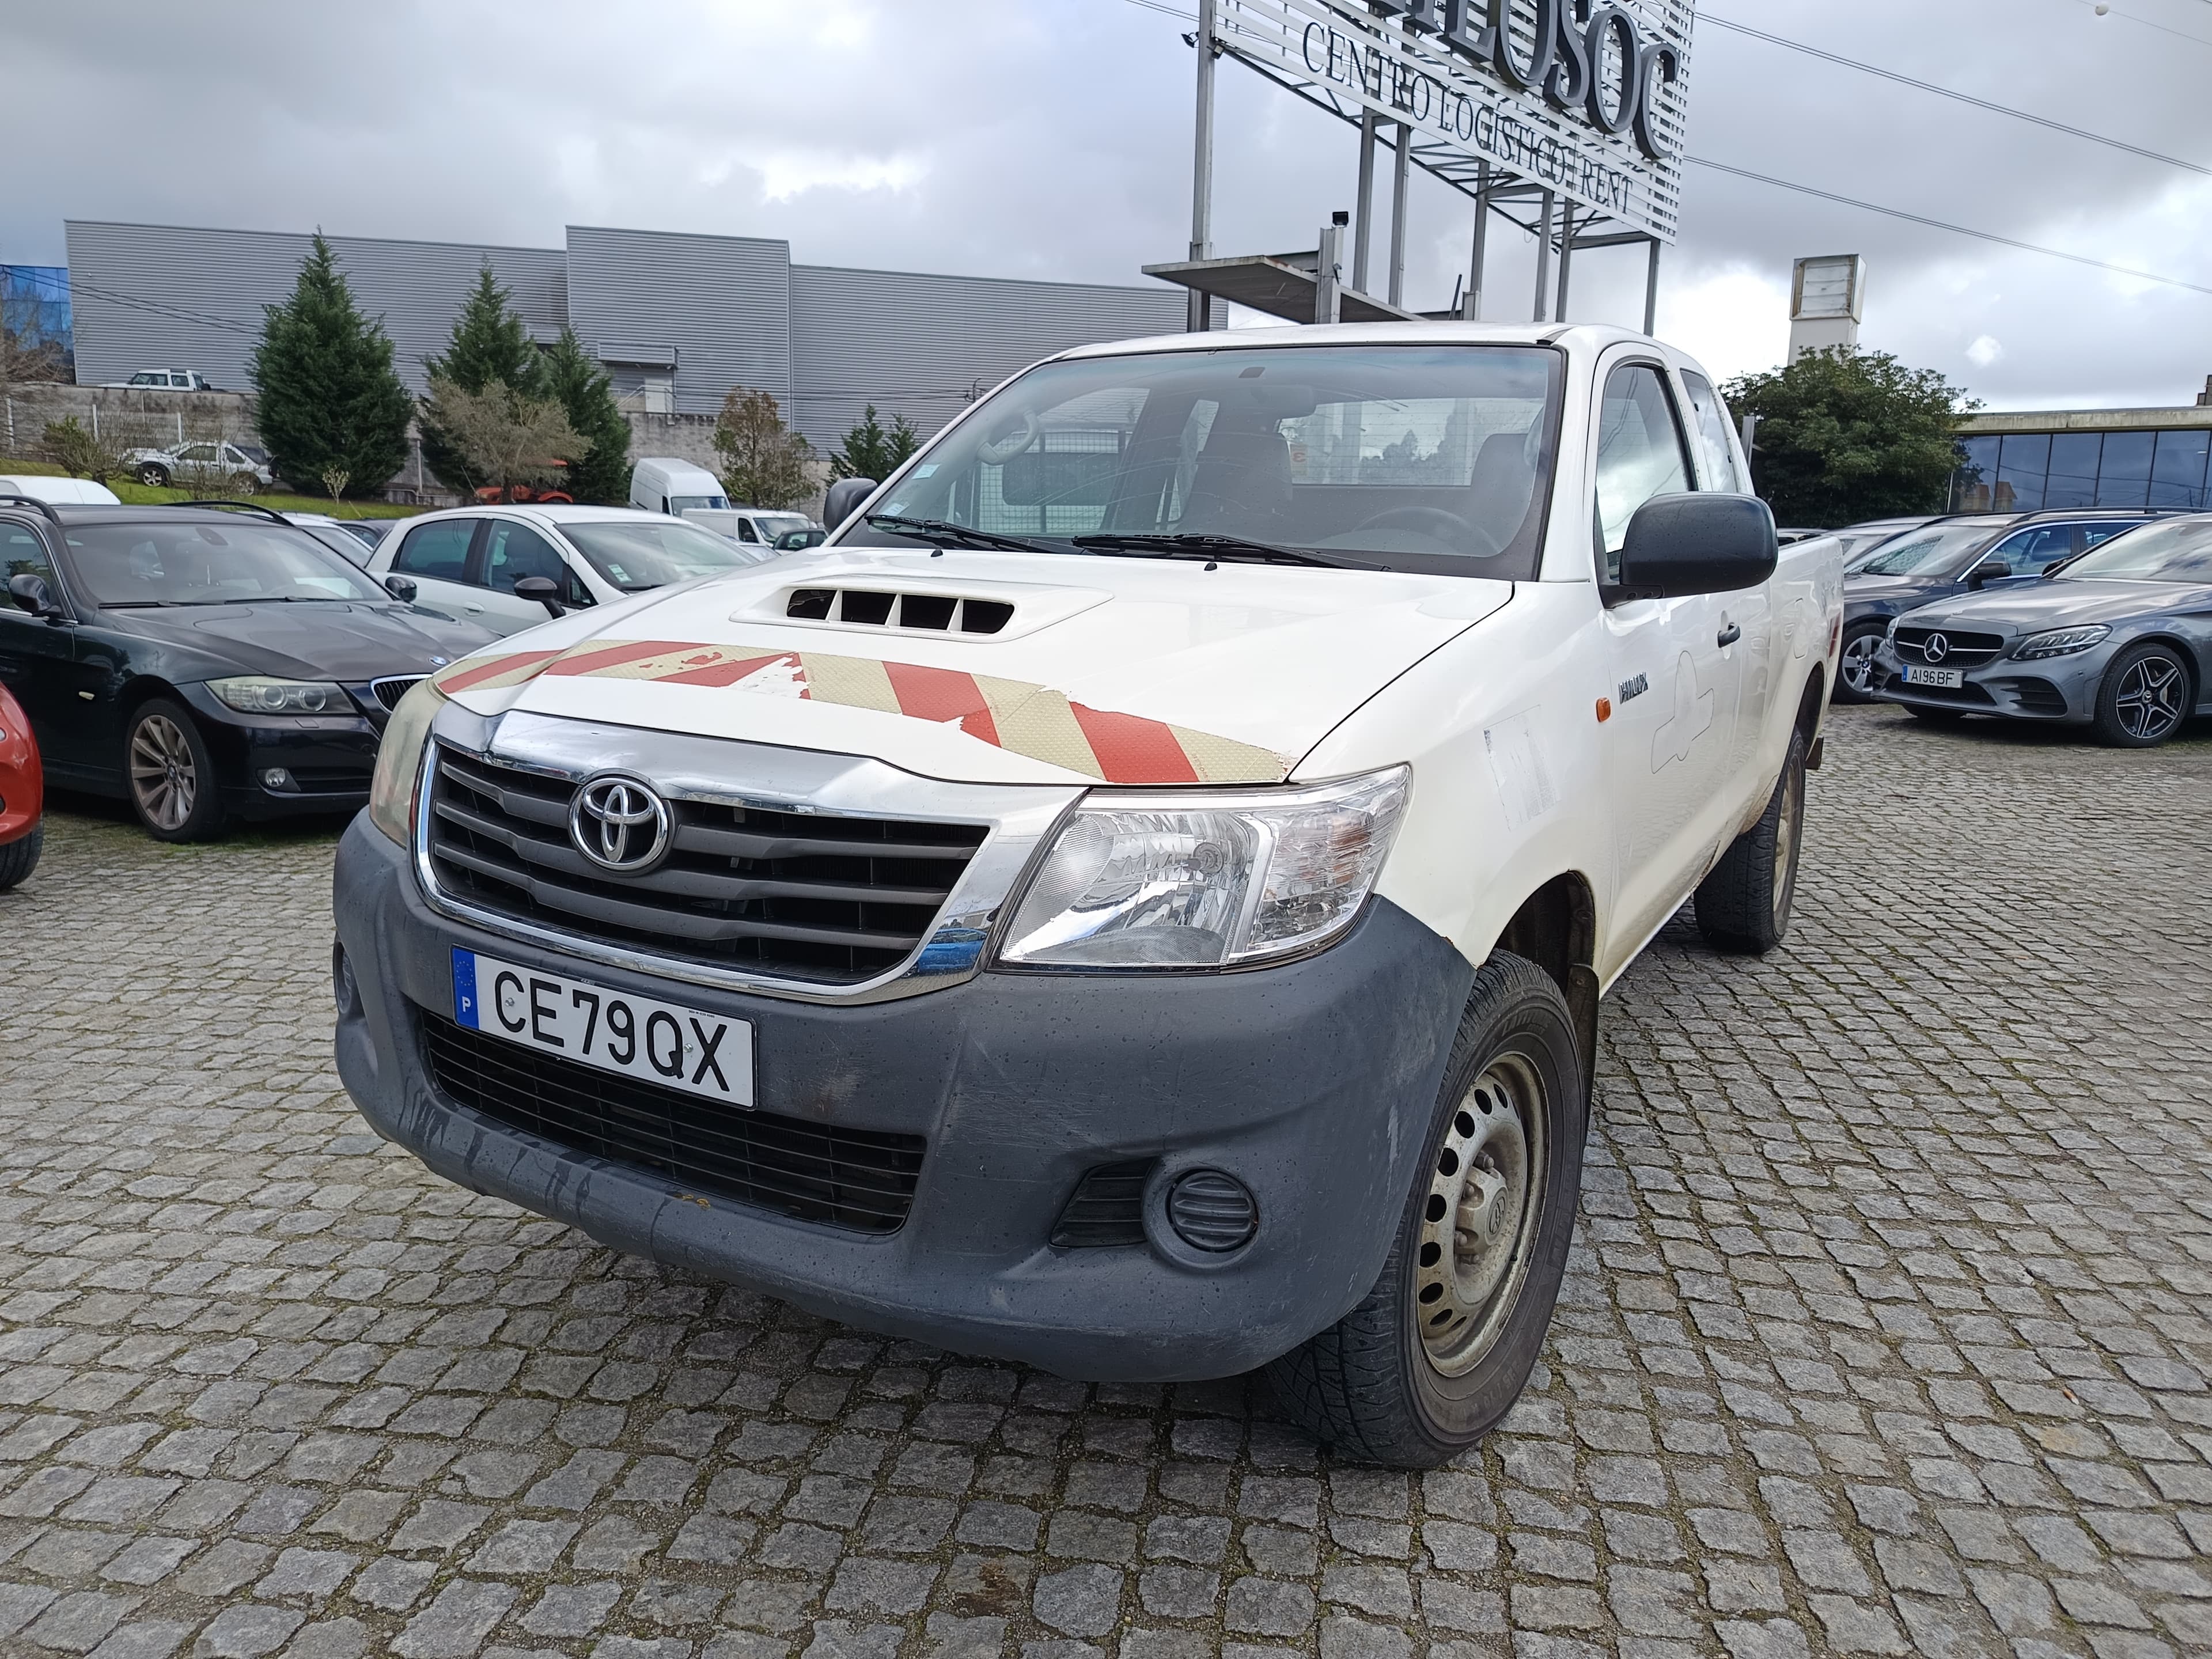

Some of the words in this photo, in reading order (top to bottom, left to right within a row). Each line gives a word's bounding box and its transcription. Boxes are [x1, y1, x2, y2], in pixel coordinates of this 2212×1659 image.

[1303, 22, 1430, 121] CENTRO
[1580, 154, 1633, 214] RENT
[1618, 672, 1649, 704] HILUX
[462, 996, 471, 1012] P
[495, 971, 730, 1092] CE79QX
